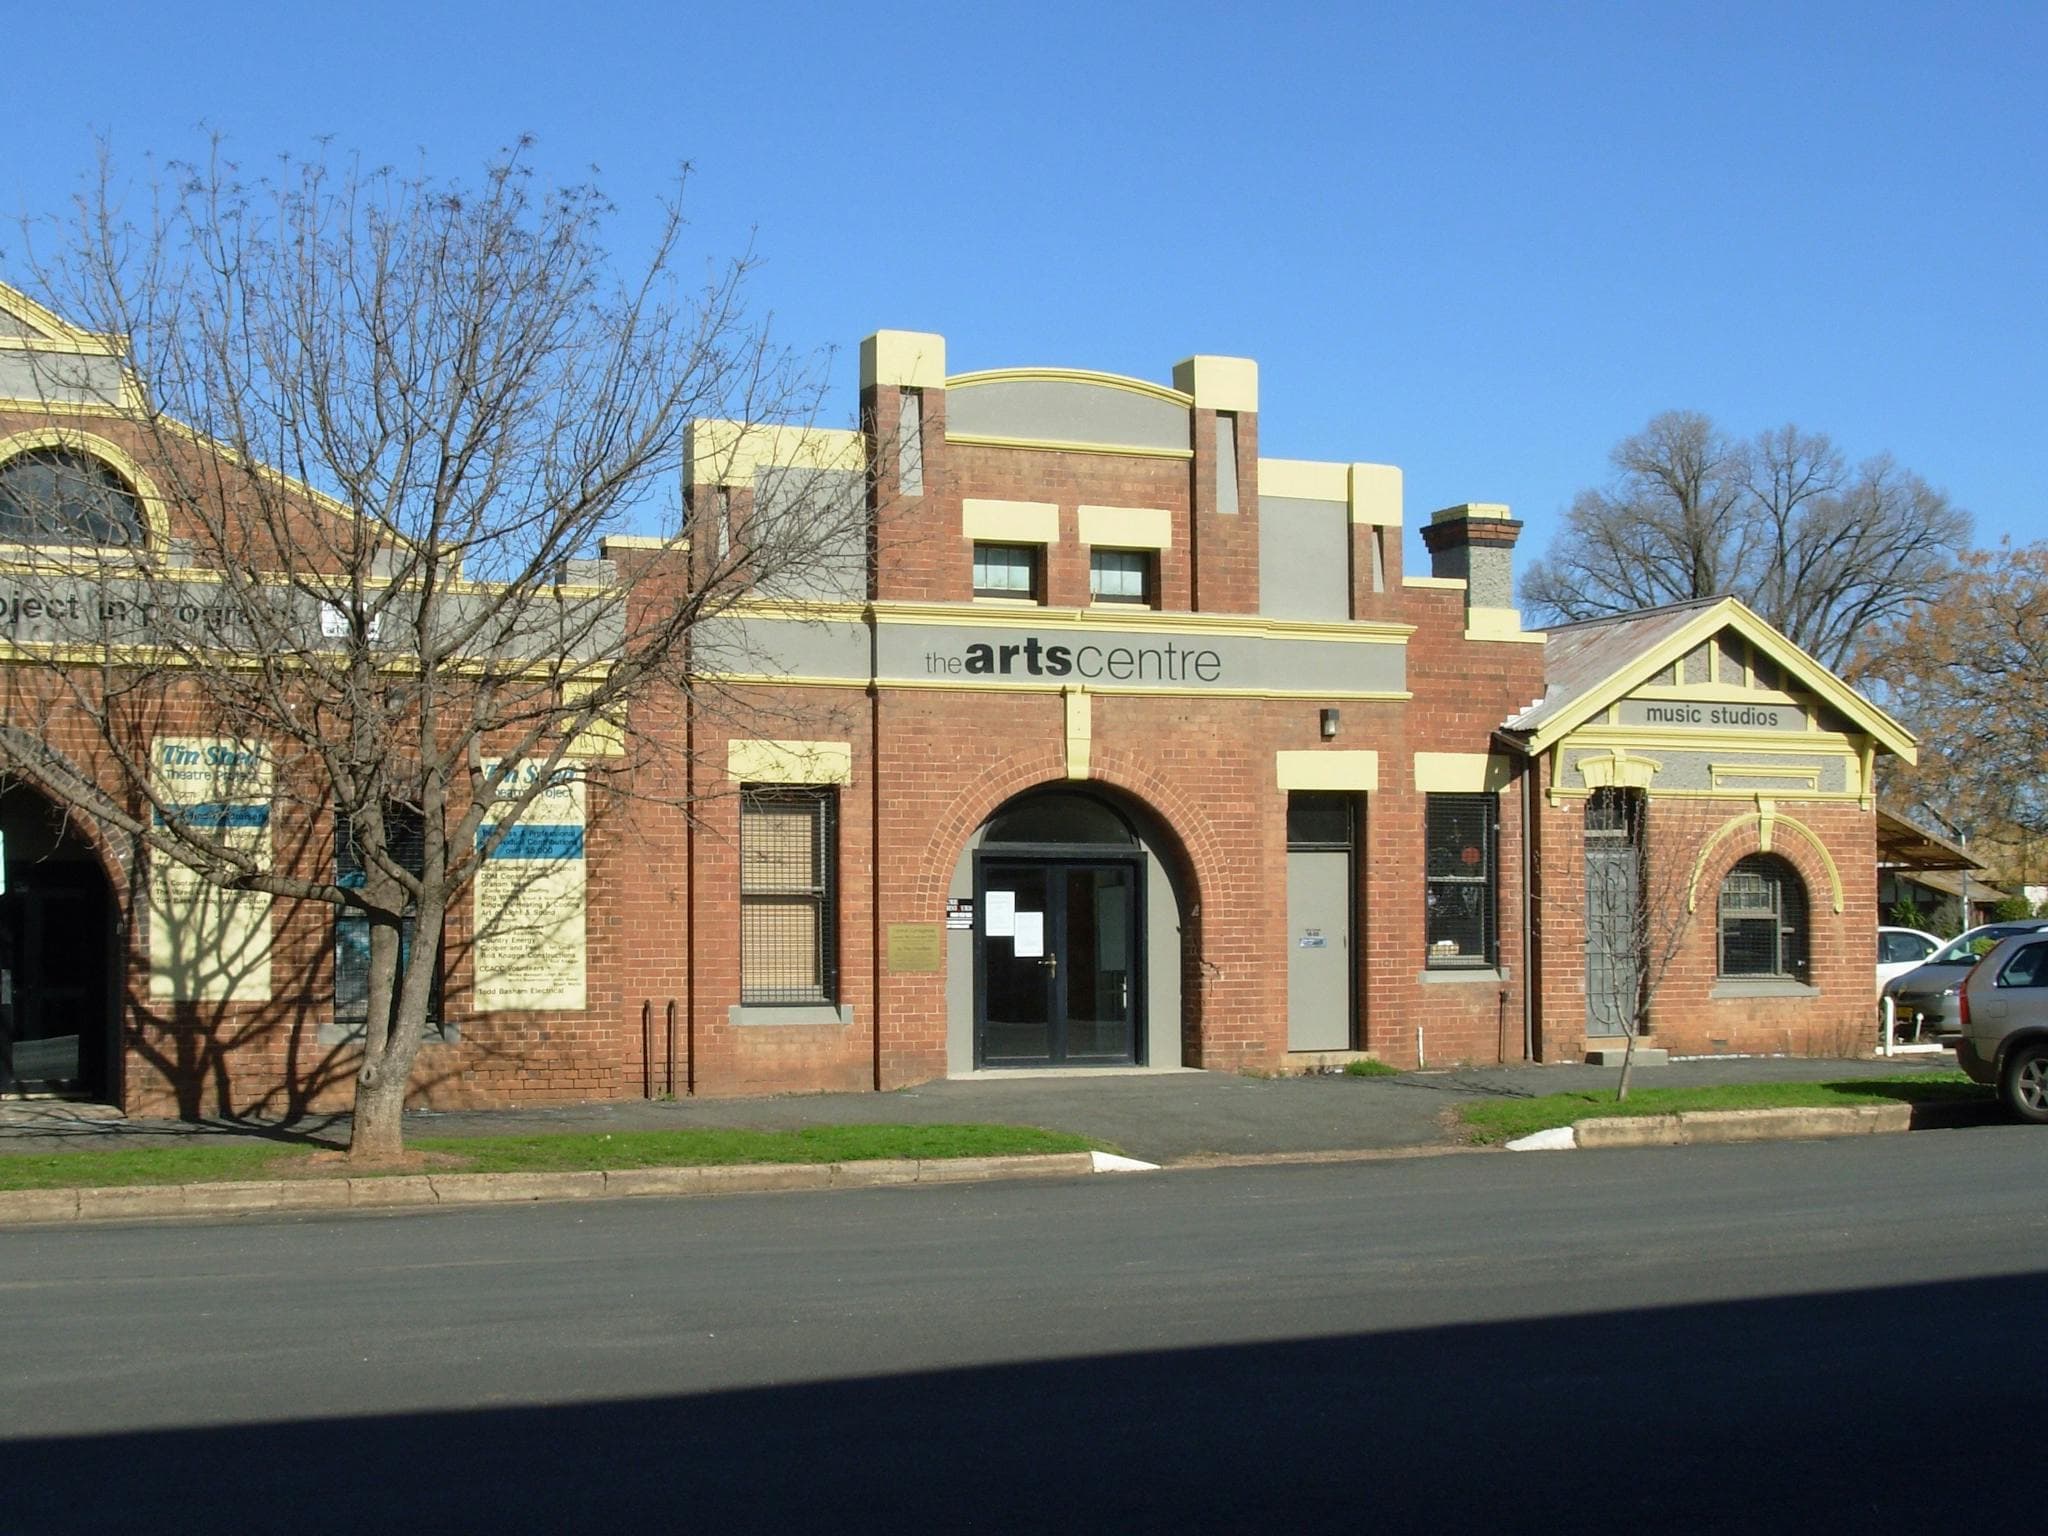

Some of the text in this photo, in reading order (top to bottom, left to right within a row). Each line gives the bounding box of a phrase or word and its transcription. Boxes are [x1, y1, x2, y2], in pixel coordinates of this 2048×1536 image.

[1646, 704, 1778, 727] music studios
[163, 745, 200, 765] Tin
[166, 769, 212, 780] Theatre
